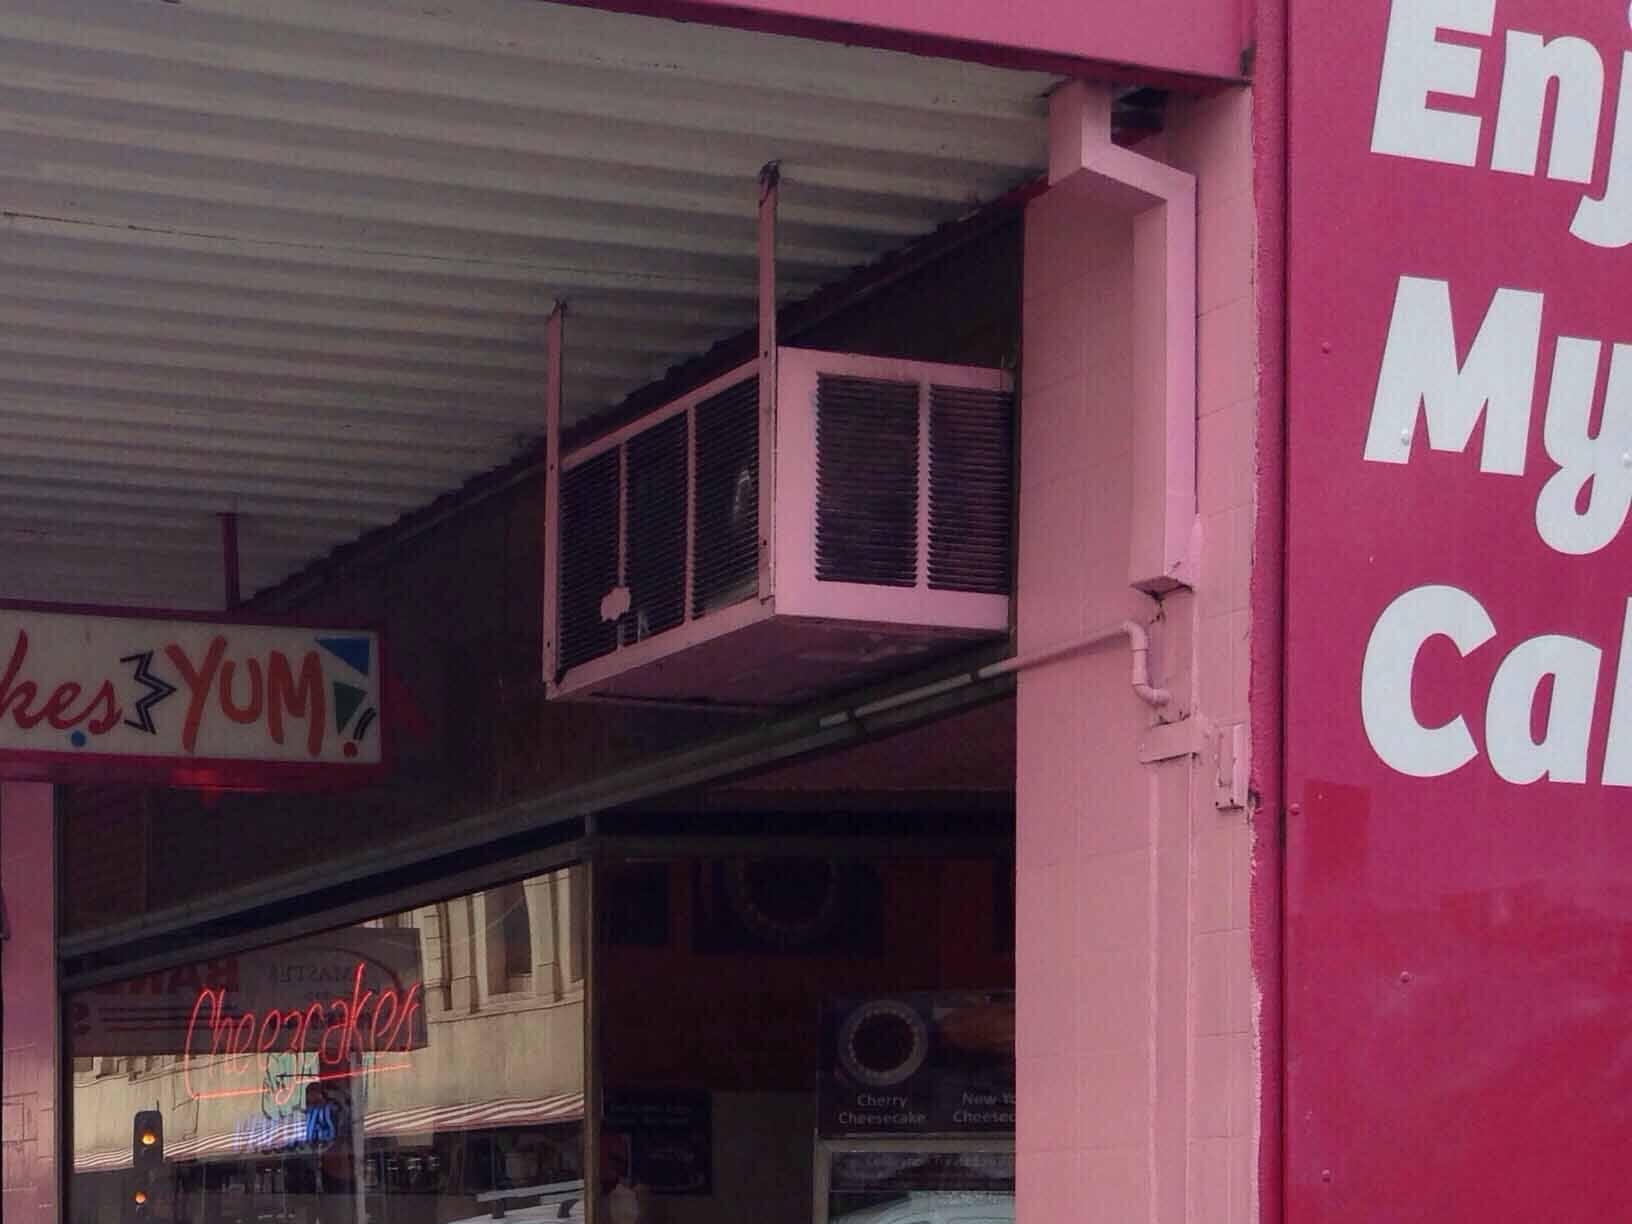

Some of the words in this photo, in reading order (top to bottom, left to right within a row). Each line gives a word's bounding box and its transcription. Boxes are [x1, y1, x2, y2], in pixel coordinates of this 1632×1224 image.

[1369, 0, 1632, 248] En
[166, 634, 326, 756] YUM
[1361, 584, 1632, 788] Ca
[838, 1110, 926, 1126] Cheesecake
